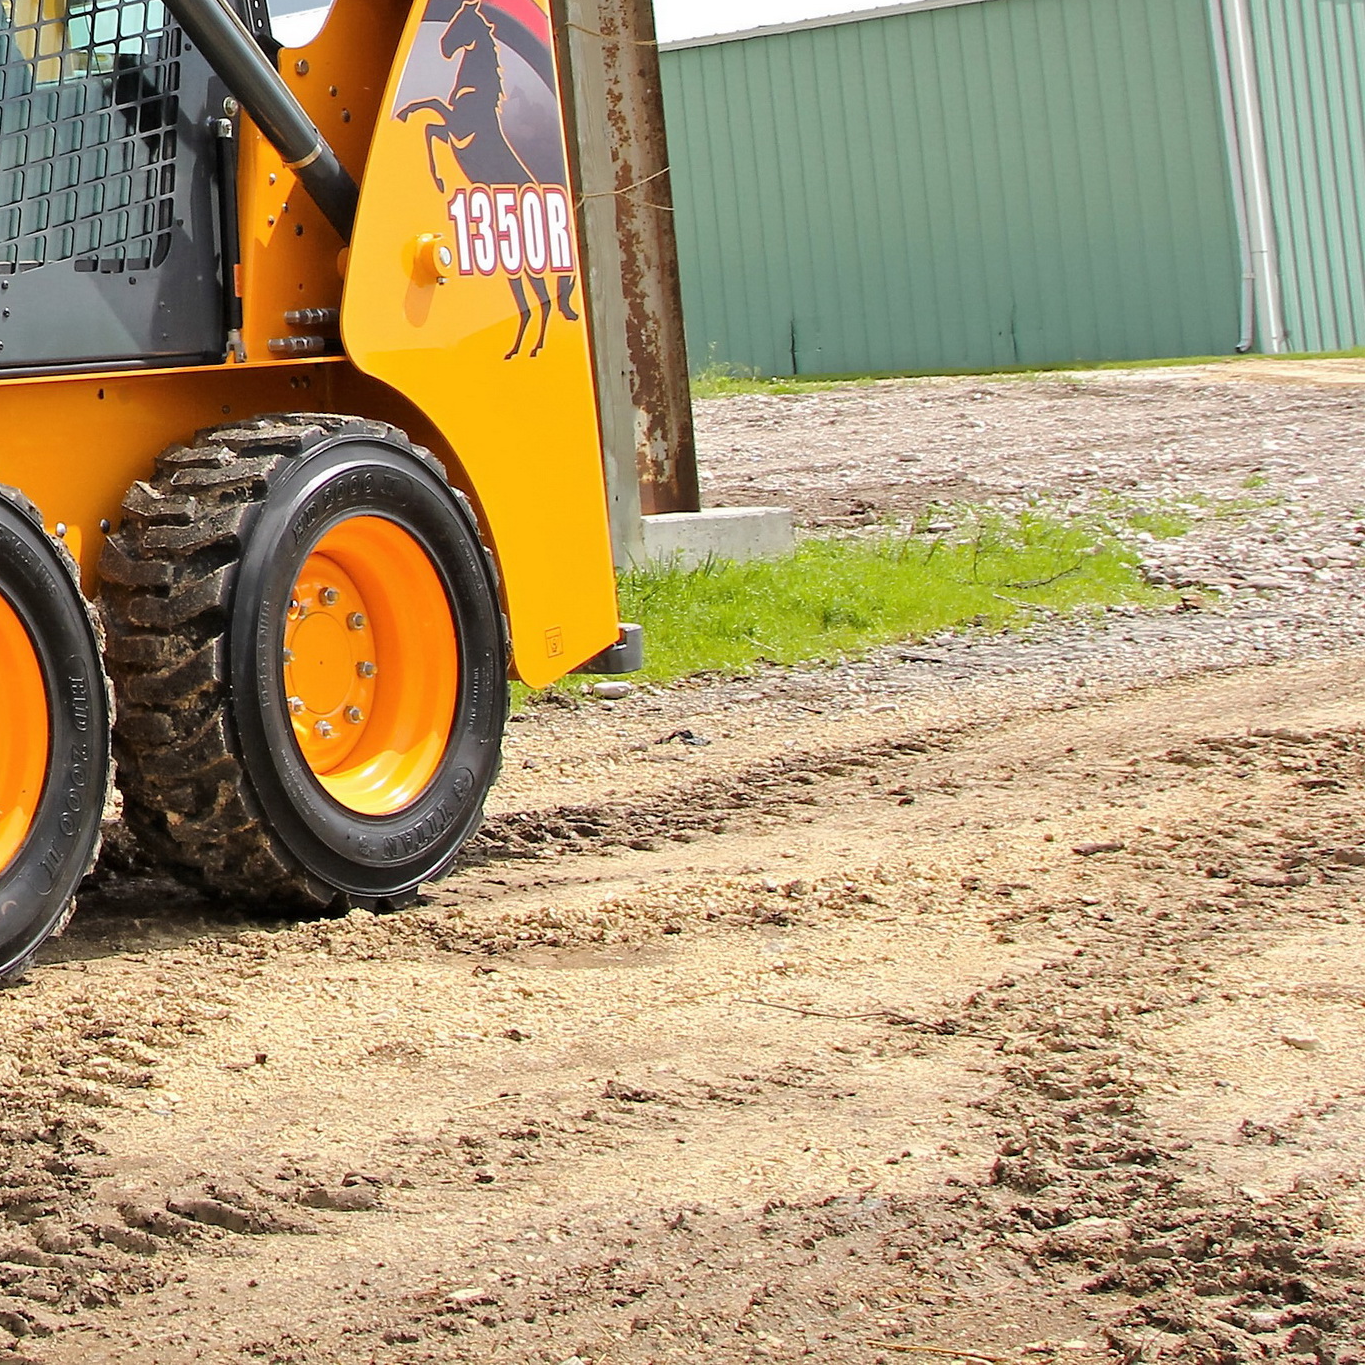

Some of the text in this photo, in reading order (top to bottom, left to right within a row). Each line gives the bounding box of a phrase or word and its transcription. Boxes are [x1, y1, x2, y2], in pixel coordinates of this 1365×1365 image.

[447, 186, 575, 276] 1350R
[59, 742, 89, 836] 2000
[382, 798, 455, 860] TITAN
